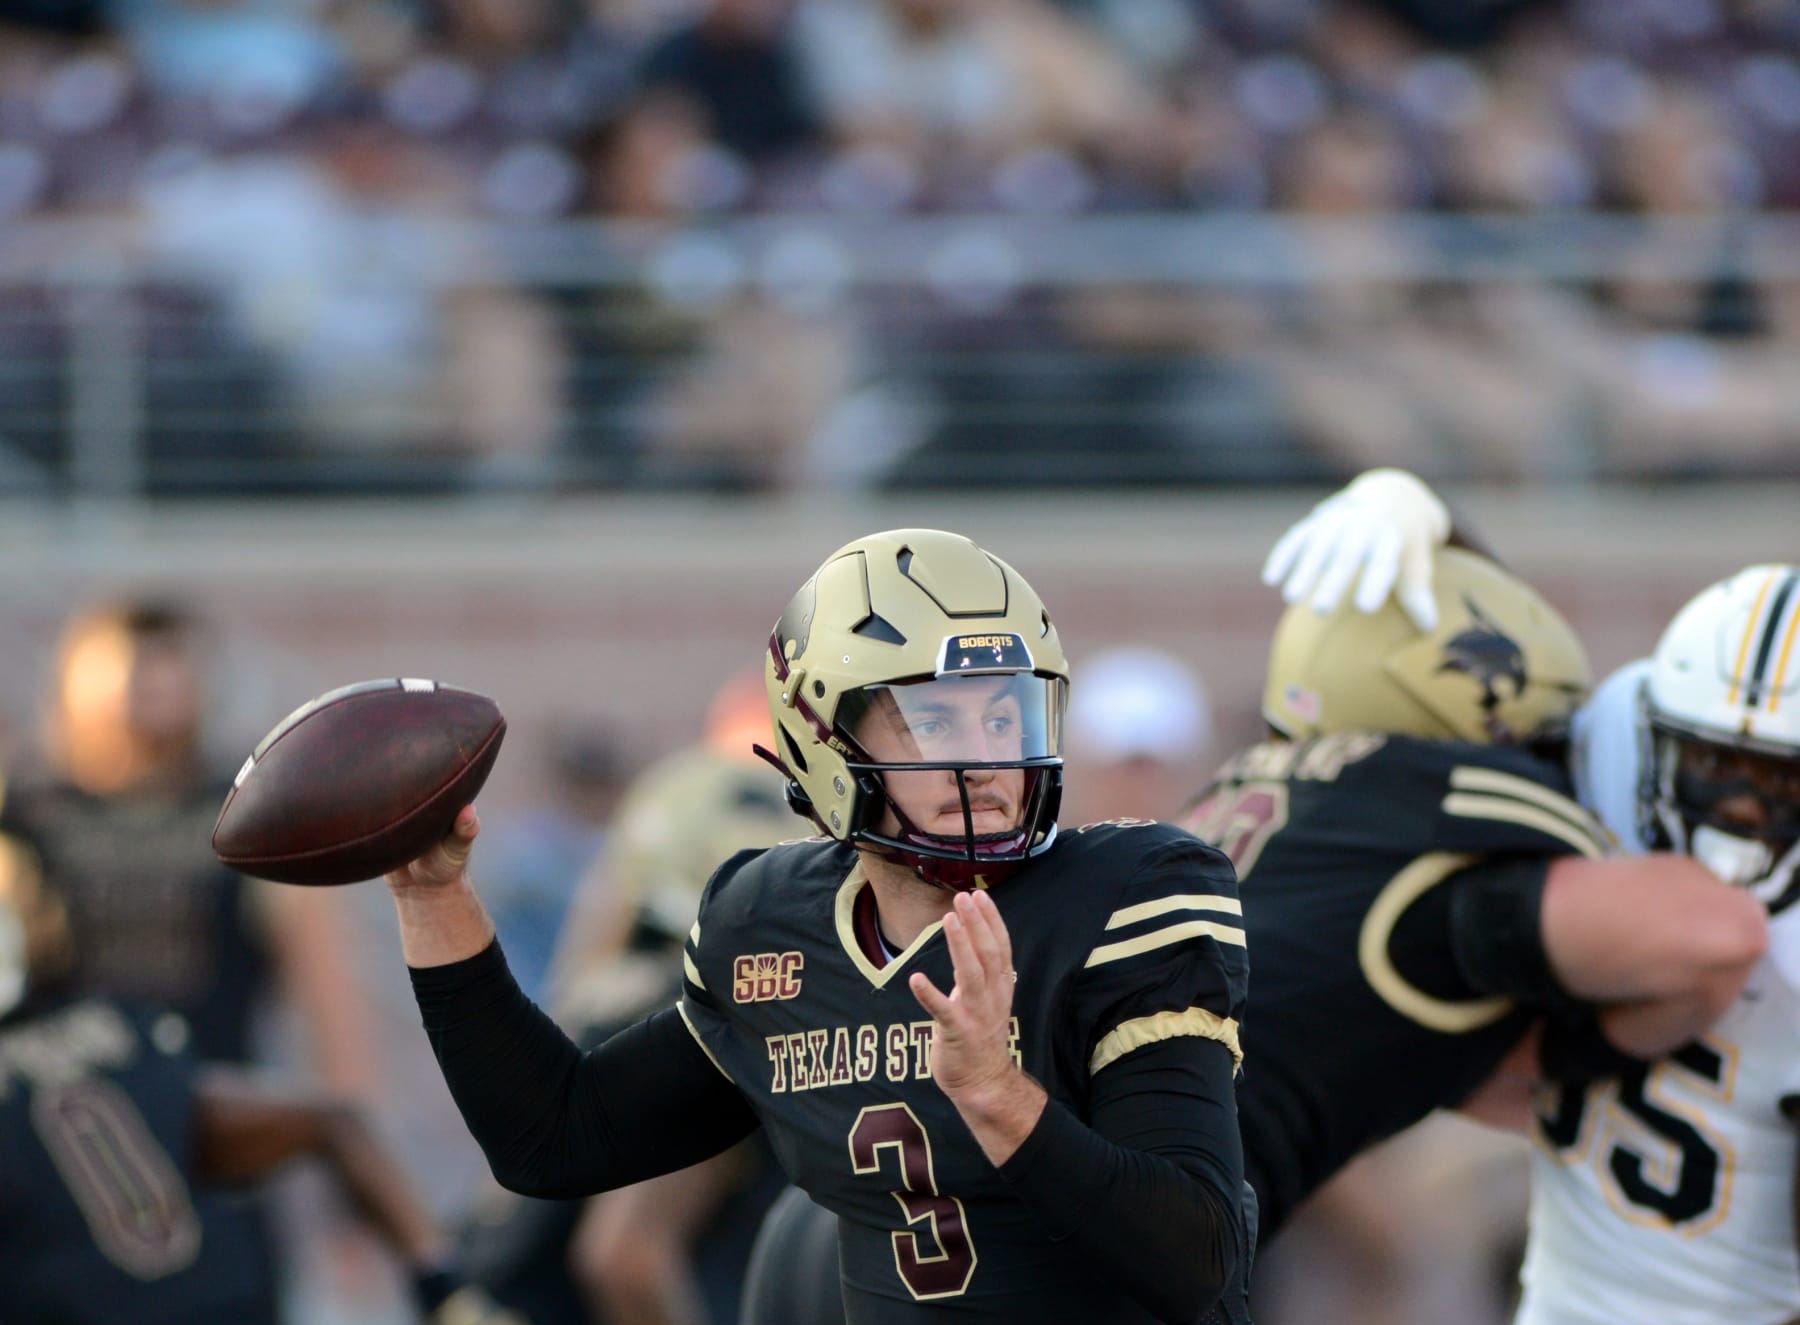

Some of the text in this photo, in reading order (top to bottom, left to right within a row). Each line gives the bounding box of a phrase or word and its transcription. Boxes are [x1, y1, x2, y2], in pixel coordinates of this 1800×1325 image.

[959, 636, 1013, 649] BOBCATS
[733, 951, 804, 1004] SBC
[765, 1016, 1022, 1093] TEXAS STE
[848, 1102, 977, 1300] 3
